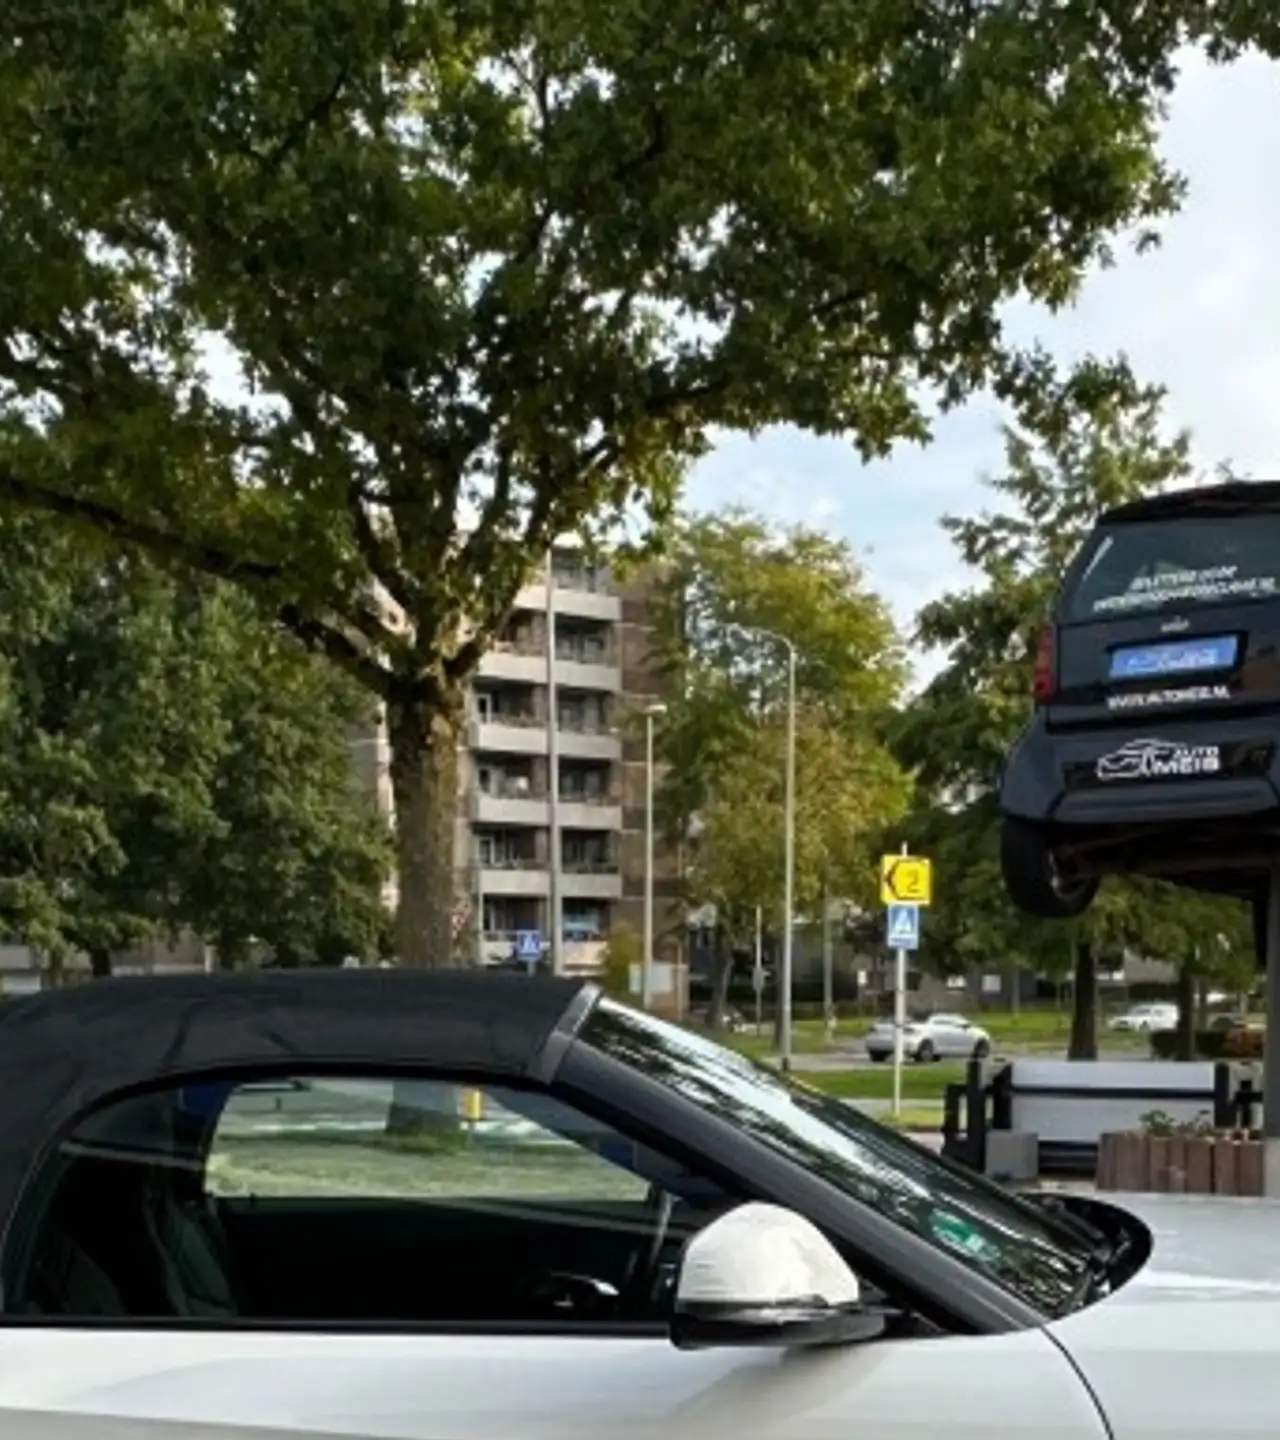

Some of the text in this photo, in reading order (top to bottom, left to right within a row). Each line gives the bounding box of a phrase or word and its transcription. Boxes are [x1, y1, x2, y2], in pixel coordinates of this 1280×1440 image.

[1173, 745, 1220, 758] AUTO
[1153, 756, 1220, 775] MEIS
[906, 869, 922, 894] 2
